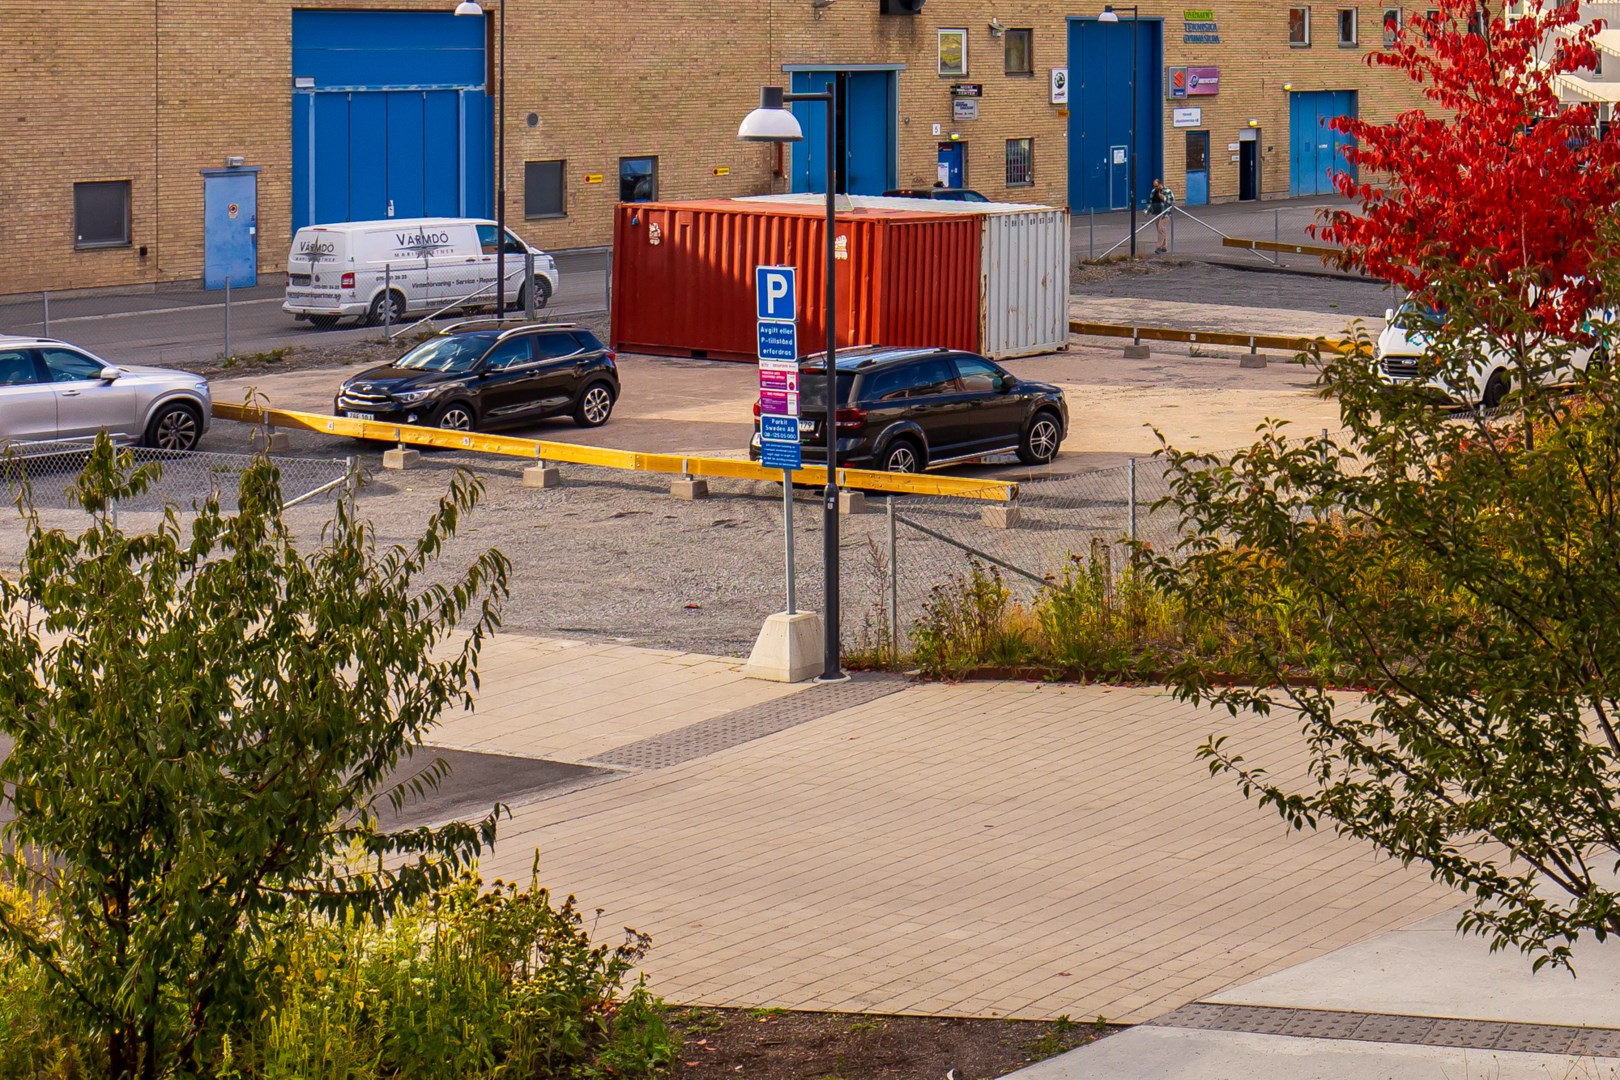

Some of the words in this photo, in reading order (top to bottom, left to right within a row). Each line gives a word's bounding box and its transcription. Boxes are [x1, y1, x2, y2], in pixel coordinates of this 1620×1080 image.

[396, 231, 449, 246] VÄRMDÖ
[300, 241, 335, 253] VÄRMDÖ
[767, 273, 788, 314] P
[760, 326, 778, 335] Avgift
[780, 327, 793, 335] eller
[761, 337, 793, 345] P-tillstånd
[763, 348, 792, 356] erfordras
